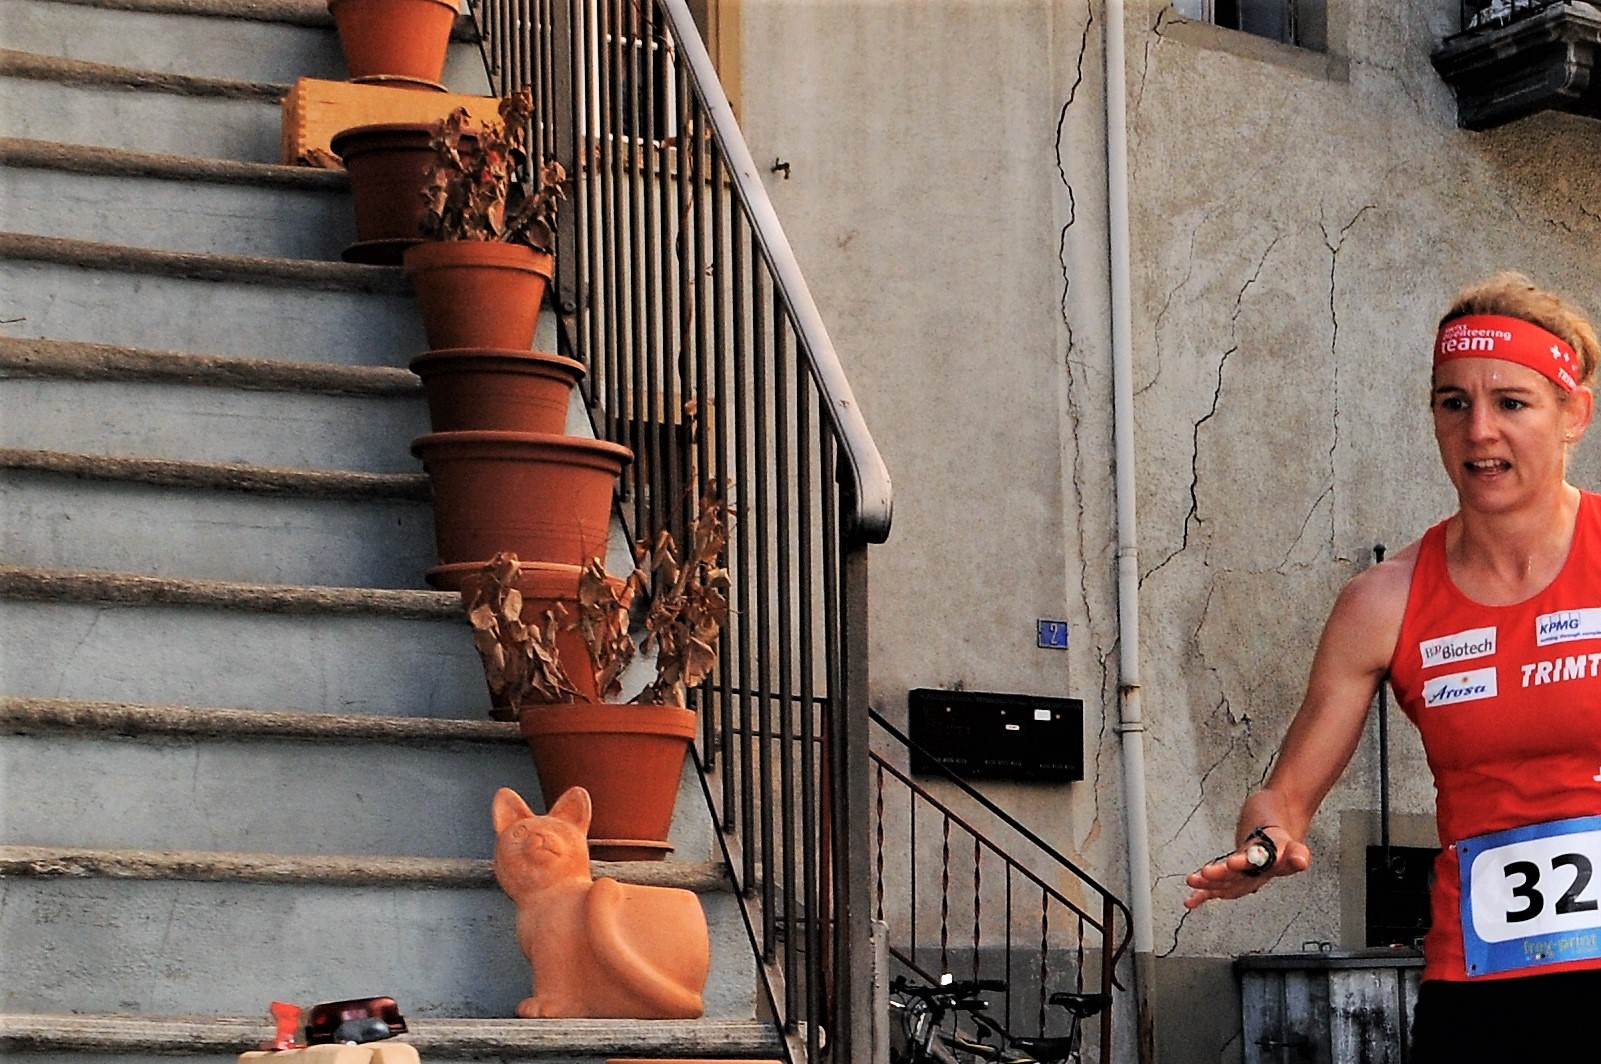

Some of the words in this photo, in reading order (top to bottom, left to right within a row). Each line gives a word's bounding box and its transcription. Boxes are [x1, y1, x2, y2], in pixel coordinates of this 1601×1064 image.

[1050, 623, 1058, 645] 2
[1540, 618, 1580, 635] KPMG
[1428, 684, 1486, 704] Arosa
[1502, 852, 1599, 924] 32
